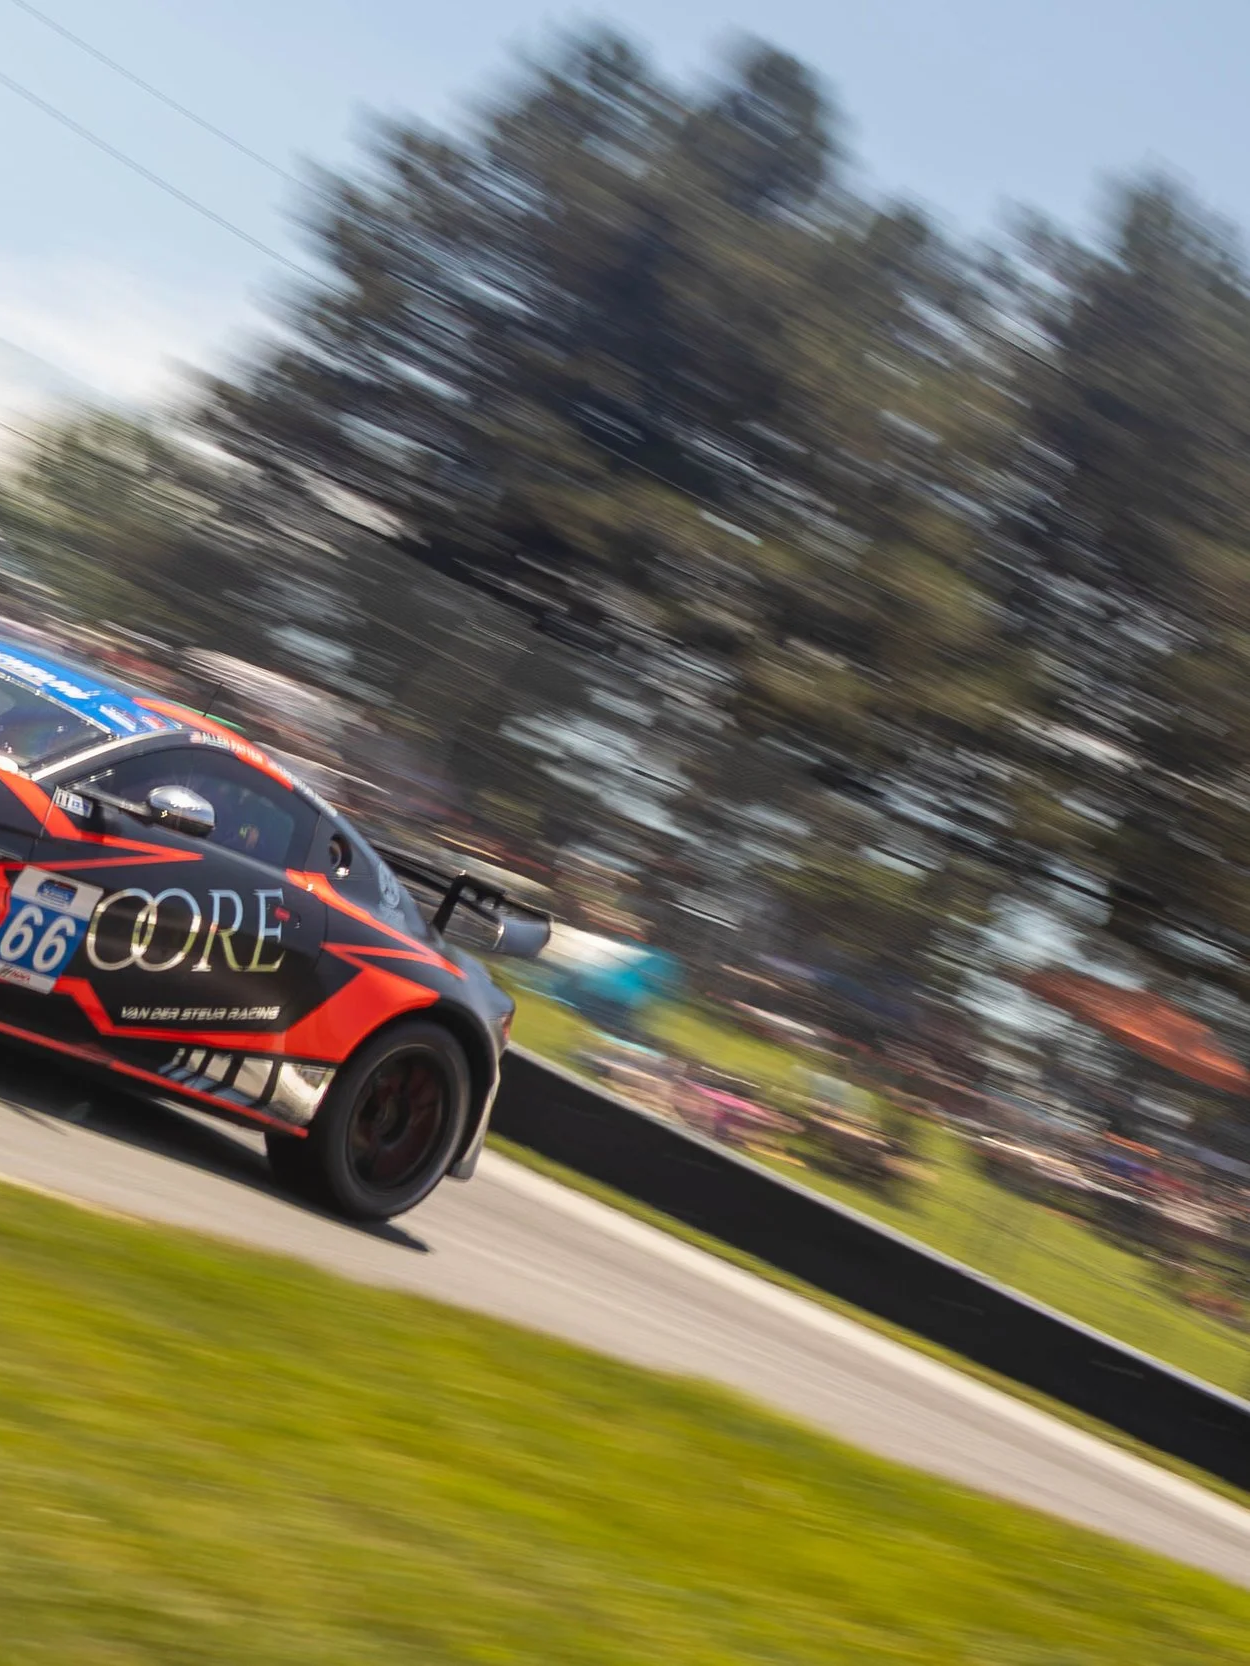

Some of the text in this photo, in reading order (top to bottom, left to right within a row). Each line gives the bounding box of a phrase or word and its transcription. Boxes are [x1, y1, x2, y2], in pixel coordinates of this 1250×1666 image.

[0, 904, 76, 973] 66
[121, 1006, 281, 1021] VAN DER STEUR RACING
